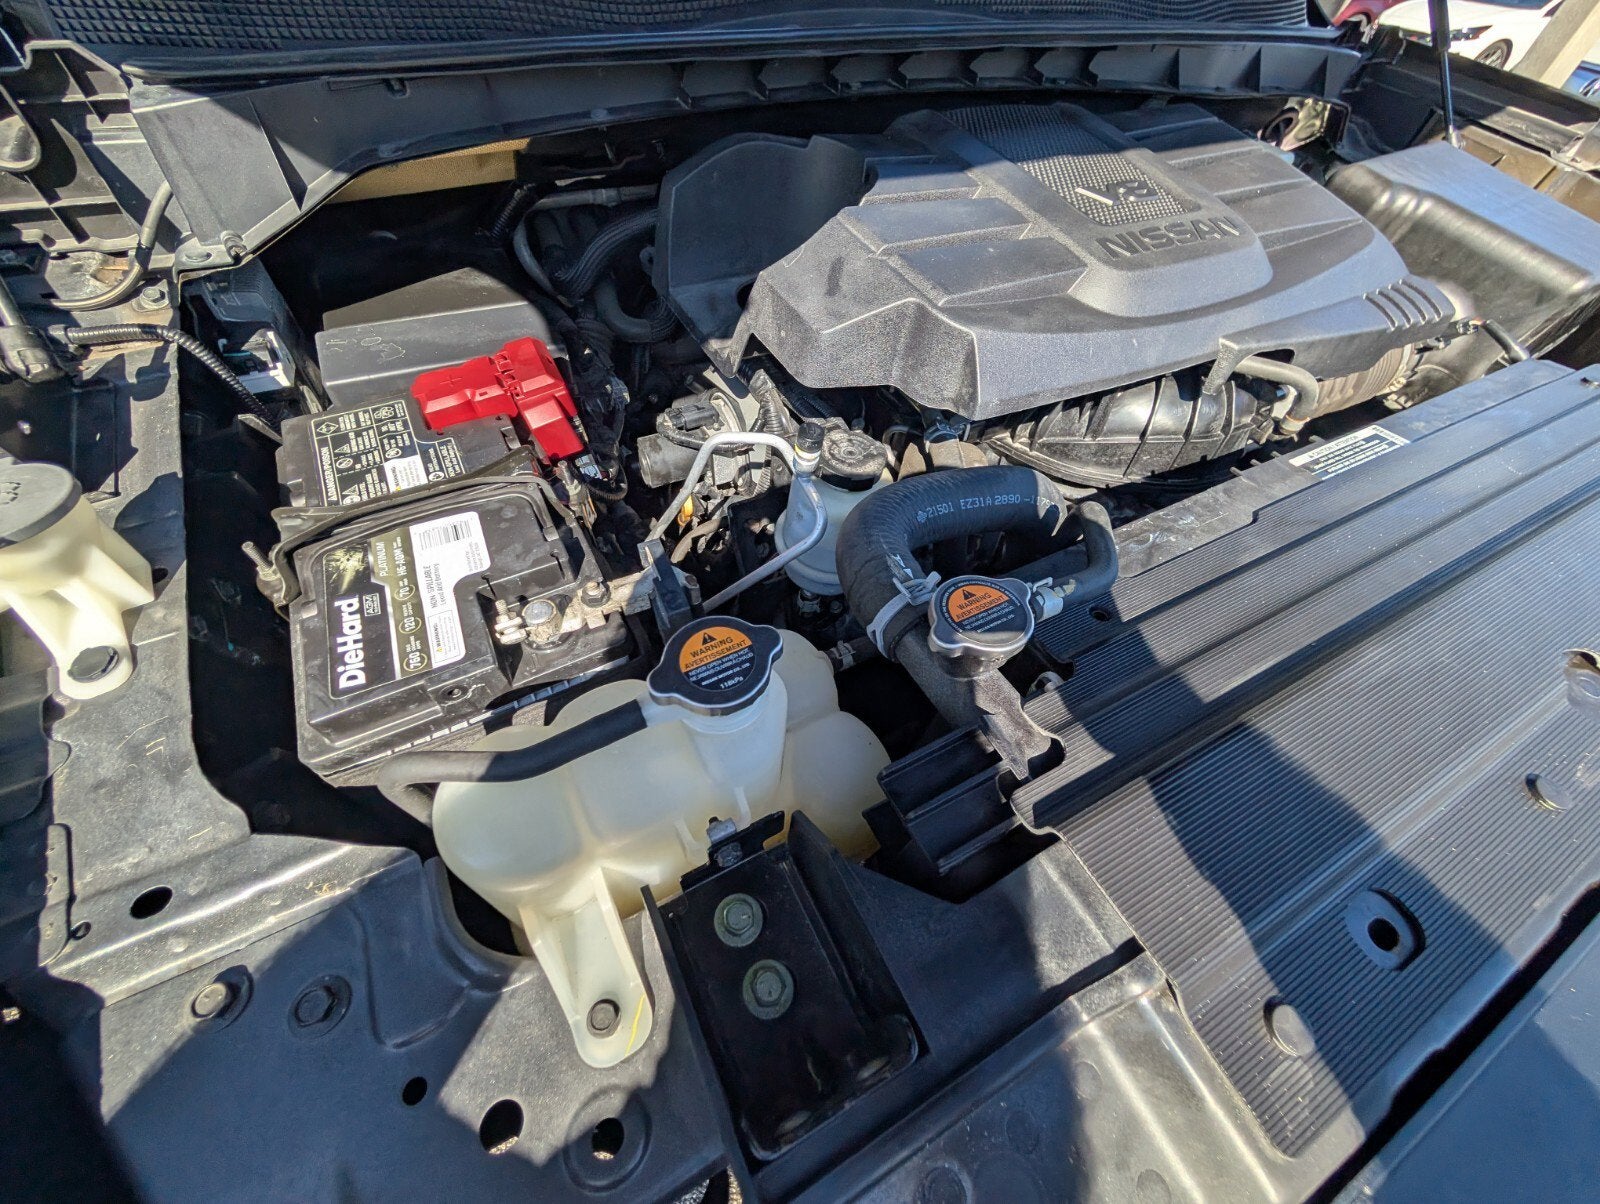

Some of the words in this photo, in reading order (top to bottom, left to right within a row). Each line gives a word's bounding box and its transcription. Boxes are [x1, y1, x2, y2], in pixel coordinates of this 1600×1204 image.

[1095, 216, 1240, 260] NISSAN
[926, 502, 955, 518] 21501
[959, 496, 993, 510] EZ31A
[994, 494, 1021, 505] 2890
[376, 542, 389, 577] PLATINUM
[399, 586, 409, 597] 70
[957, 591, 991, 611] WARNING
[956, 594, 1004, 620] AVERTISSEMENT
[403, 616, 415, 631] 120
[334, 595, 366, 689] DieHard
[685, 640, 747, 669] AVERTISSEMENT
[690, 636, 734, 658] WARNING
